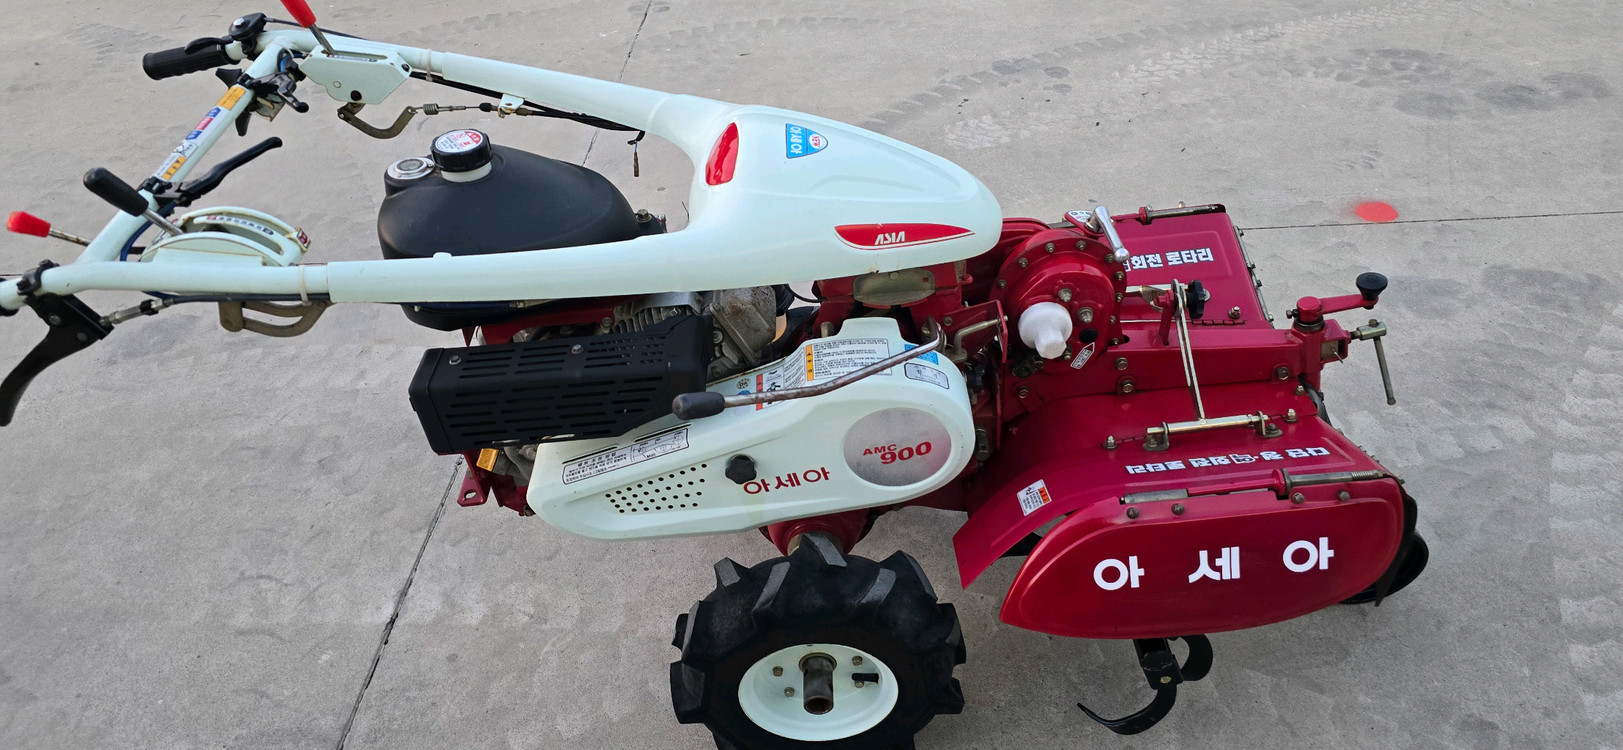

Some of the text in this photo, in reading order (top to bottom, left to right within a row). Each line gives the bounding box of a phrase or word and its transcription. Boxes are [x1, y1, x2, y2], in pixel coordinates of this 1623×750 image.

[790, 126, 803, 154] 아세아
[874, 231, 906, 246] ASIA
[1165, 247, 1215, 266] 로타리
[862, 444, 898, 456] AMC
[880, 441, 932, 465] 900
[1285, 446, 1331, 458] 다단
[1125, 460, 1187, 475] 로타리
[743, 466, 830, 495] 아세아
[1093, 536, 1335, 591] 아 세 아
